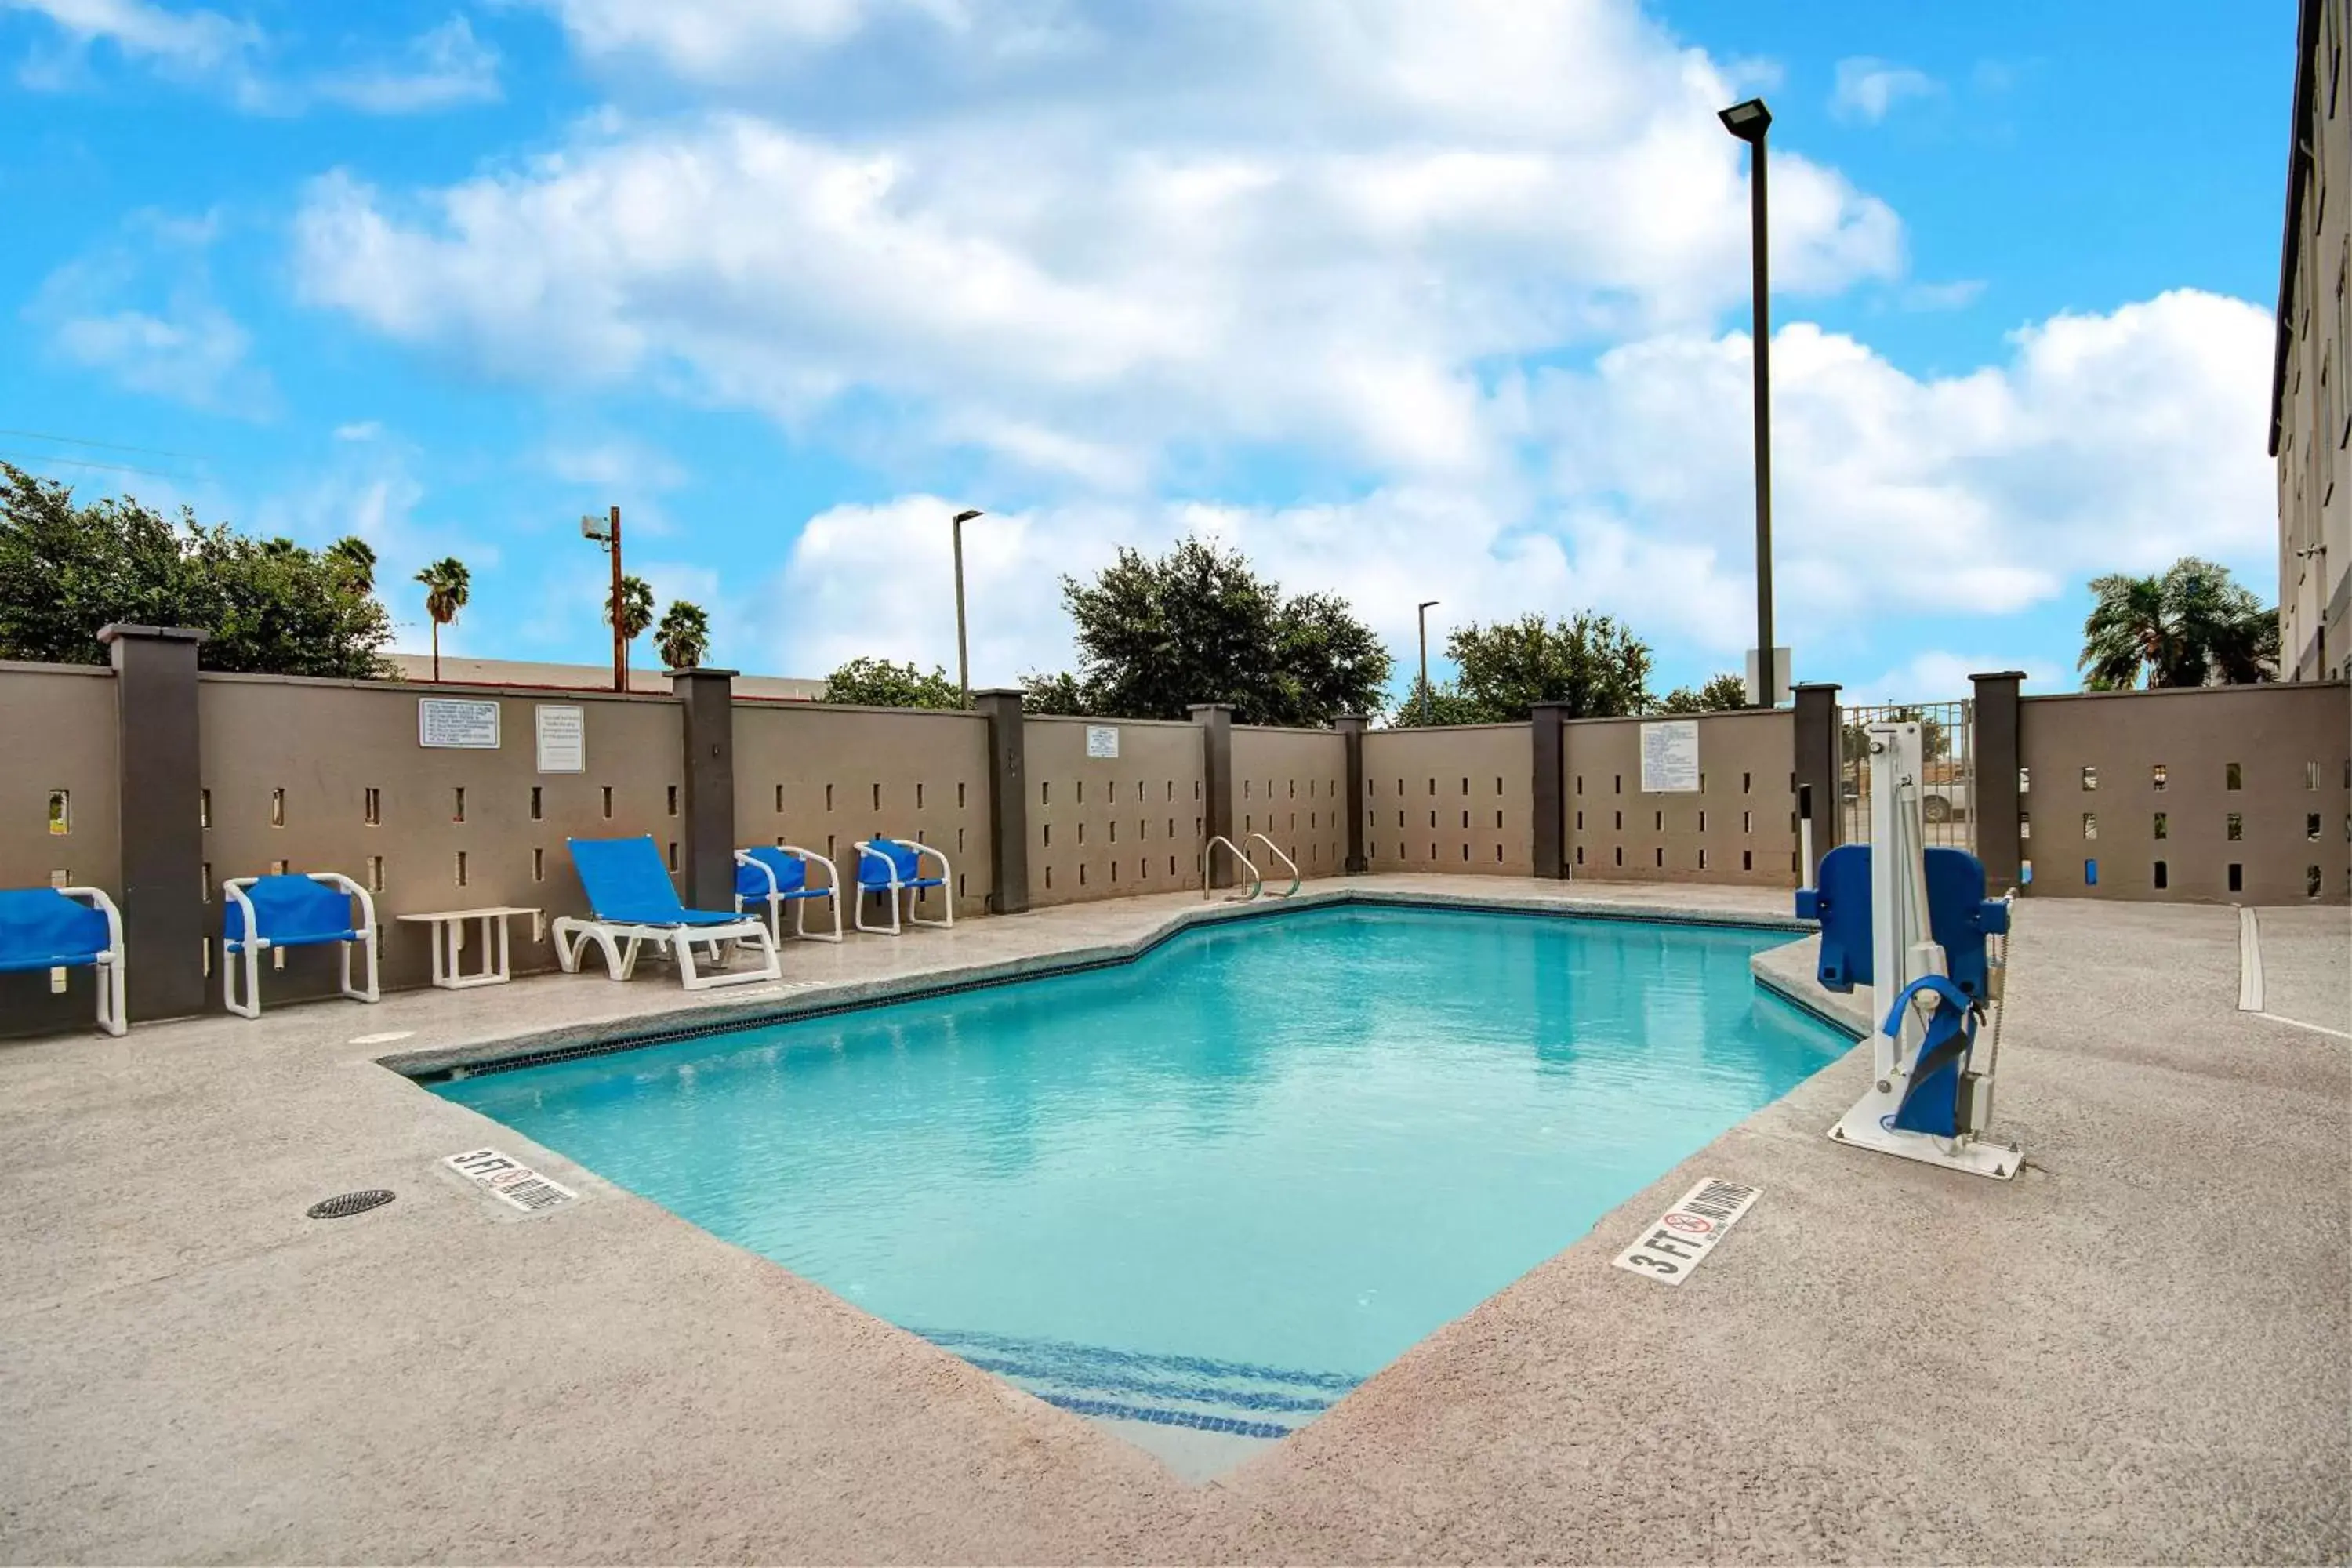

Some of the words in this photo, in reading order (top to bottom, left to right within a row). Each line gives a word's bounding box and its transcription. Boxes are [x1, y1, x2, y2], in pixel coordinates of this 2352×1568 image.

[454, 1152, 492, 1163] 3
[464, 1158, 516, 1175] FT
[1643, 1229, 1703, 1260] FT
[1628, 1254, 1679, 1274] 3
